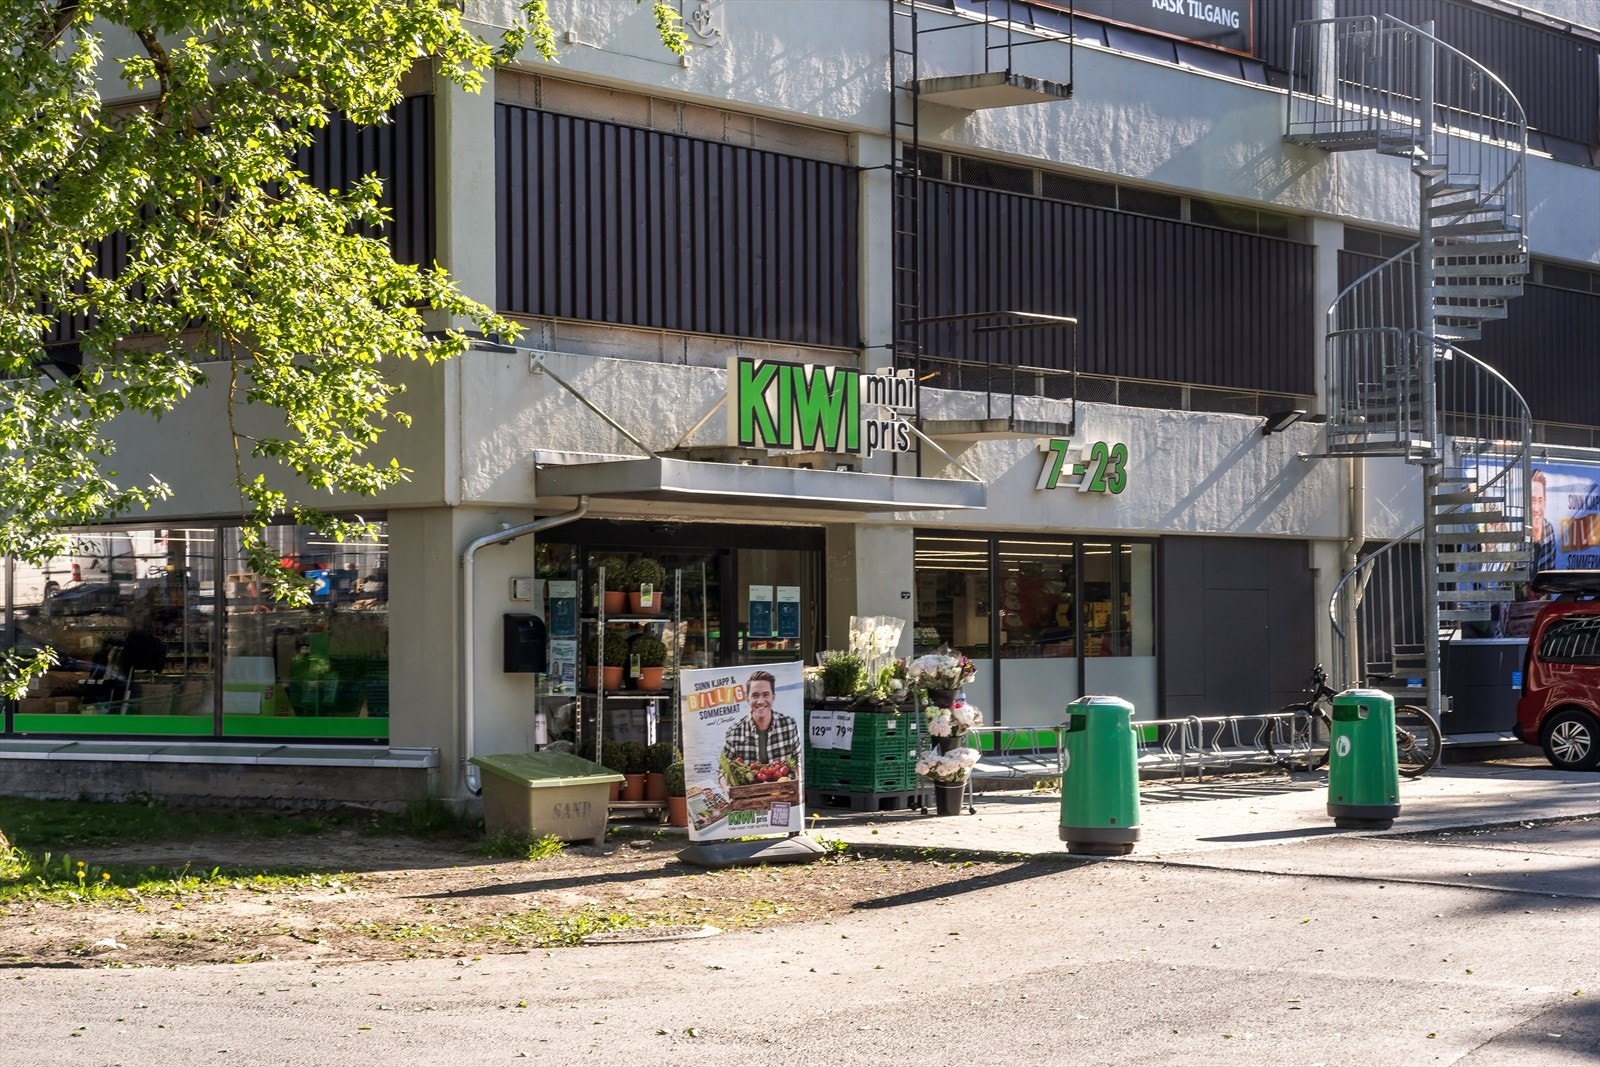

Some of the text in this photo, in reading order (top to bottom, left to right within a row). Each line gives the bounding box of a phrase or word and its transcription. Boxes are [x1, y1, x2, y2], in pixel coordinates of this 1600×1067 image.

[1187, 0, 1240, 29] TILGANG
[866, 367, 916, 409] mini
[736, 356, 862, 455] KIWI
[866, 412, 911, 459] pris
[1044, 438, 1129, 495] 7-23
[694, 676, 737, 692] SUNN KJAPP &
[688, 685, 745, 711] BILLIG
[699, 703, 741, 721] SOMMERMAT
[811, 726, 826, 737] 129
[836, 725, 847, 738] 79
[553, 801, 592, 819] SAND
[728, 810, 756, 826] KIWI
[756, 815, 768, 825] pris
